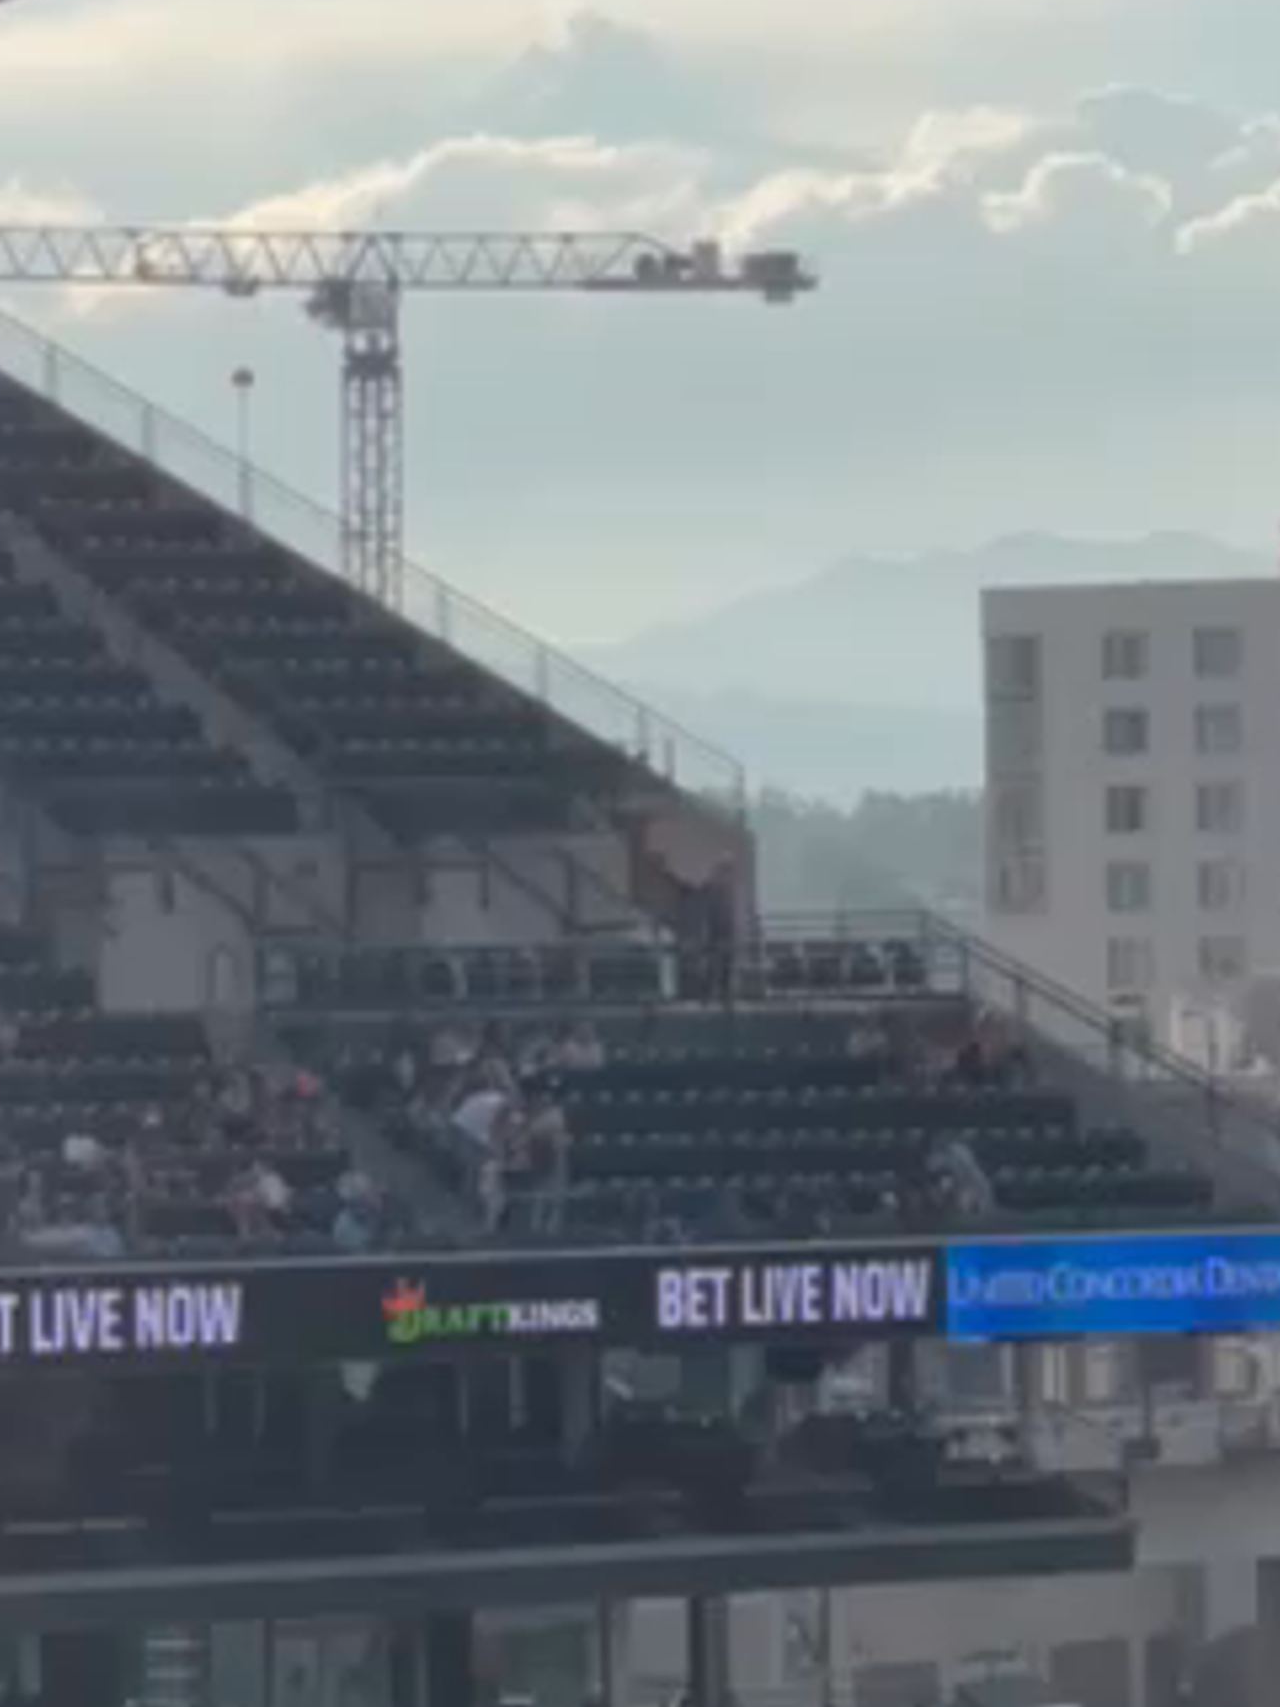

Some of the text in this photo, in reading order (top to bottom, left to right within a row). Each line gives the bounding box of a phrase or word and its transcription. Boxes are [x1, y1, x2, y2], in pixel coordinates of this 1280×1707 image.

[29, 1288, 123, 1353] LIVE
[135, 1283, 242, 1346] NOW
[658, 1259, 930, 1329] BET LIVE NOW
